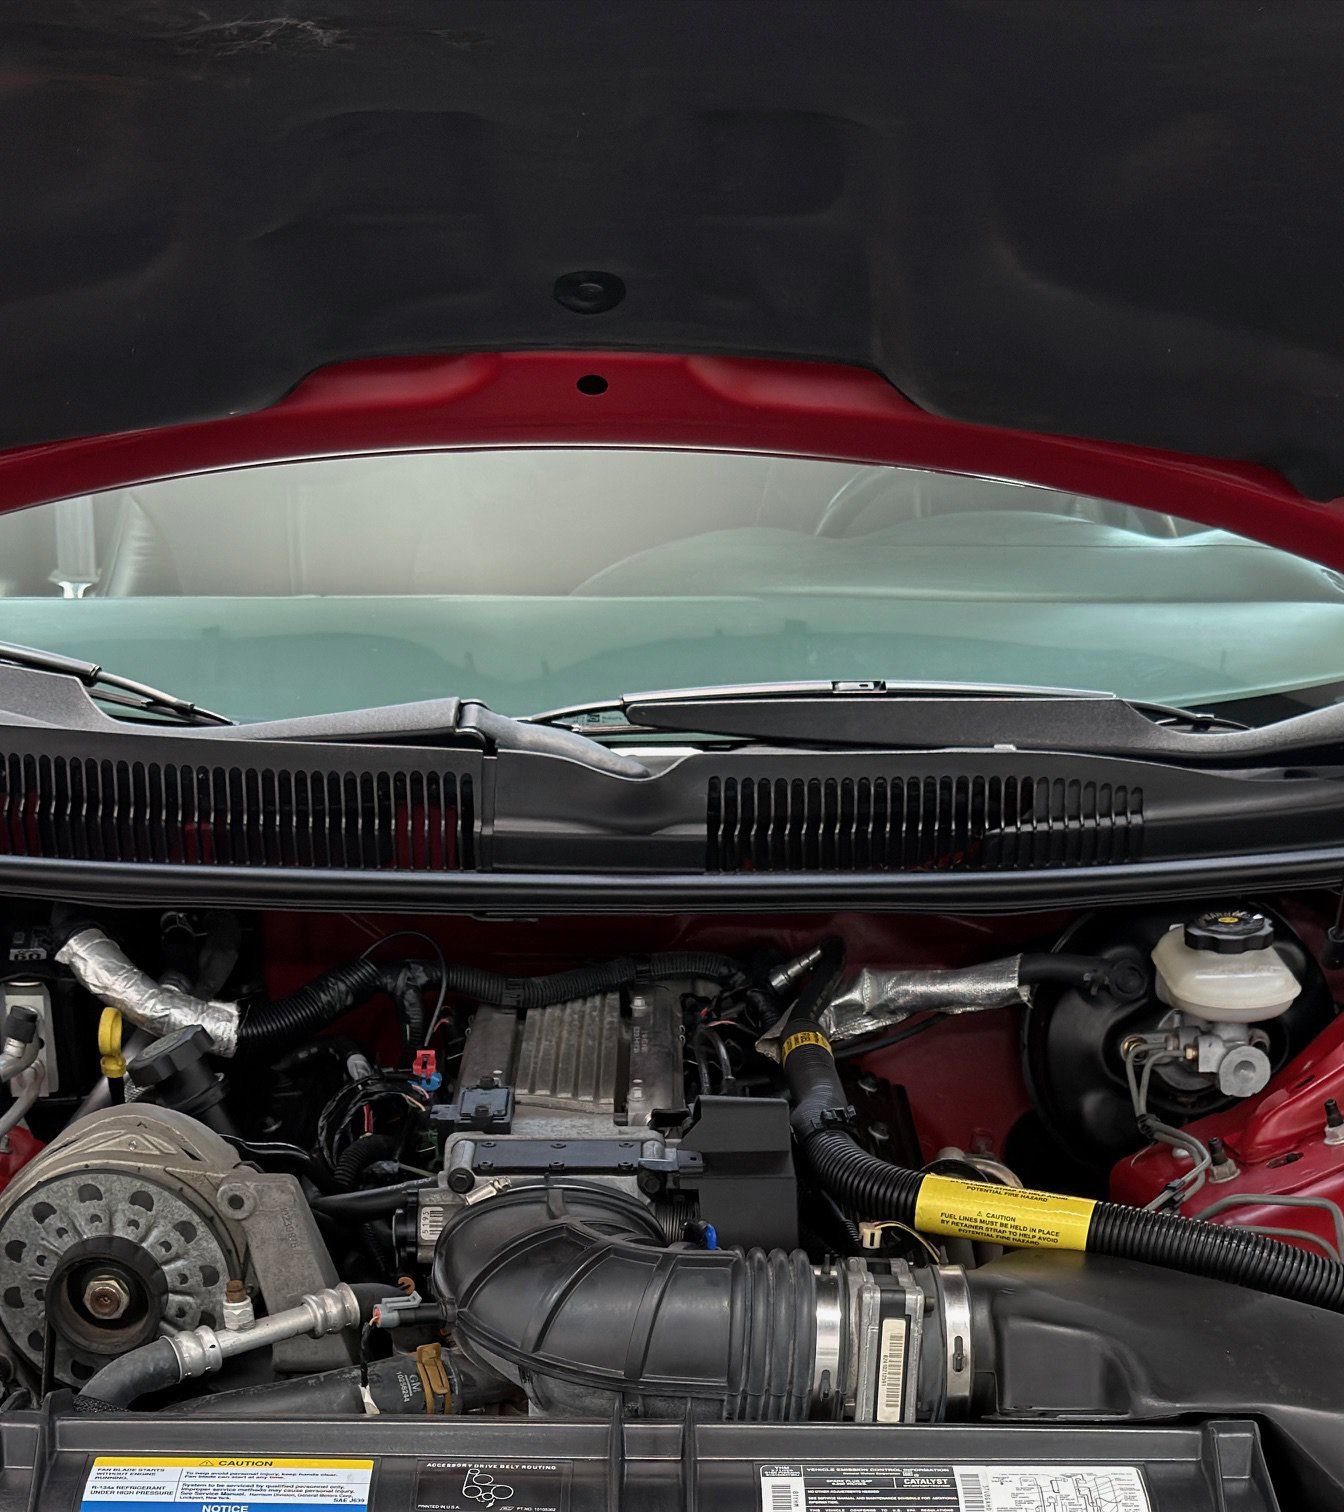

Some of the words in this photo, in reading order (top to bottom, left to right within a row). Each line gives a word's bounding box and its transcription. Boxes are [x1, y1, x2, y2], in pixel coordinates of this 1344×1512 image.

[966, 1186, 1002, 1195] POTENTIAL
[1021, 1194, 1048, 1202] HAZARD
[986, 1213, 1016, 1222] CAUTION
[951, 1222, 983, 1231] RETAINER
[986, 1227, 1006, 1235] STRAP
[1038, 1235, 1058, 1243] AVOID
[958, 1229, 993, 1238] POTENTIAL
[1013, 1237, 1039, 1245] HAZARD
[1038, 1228, 1060, 1236] PLACE
[410, 1374, 422, 1392] GM
